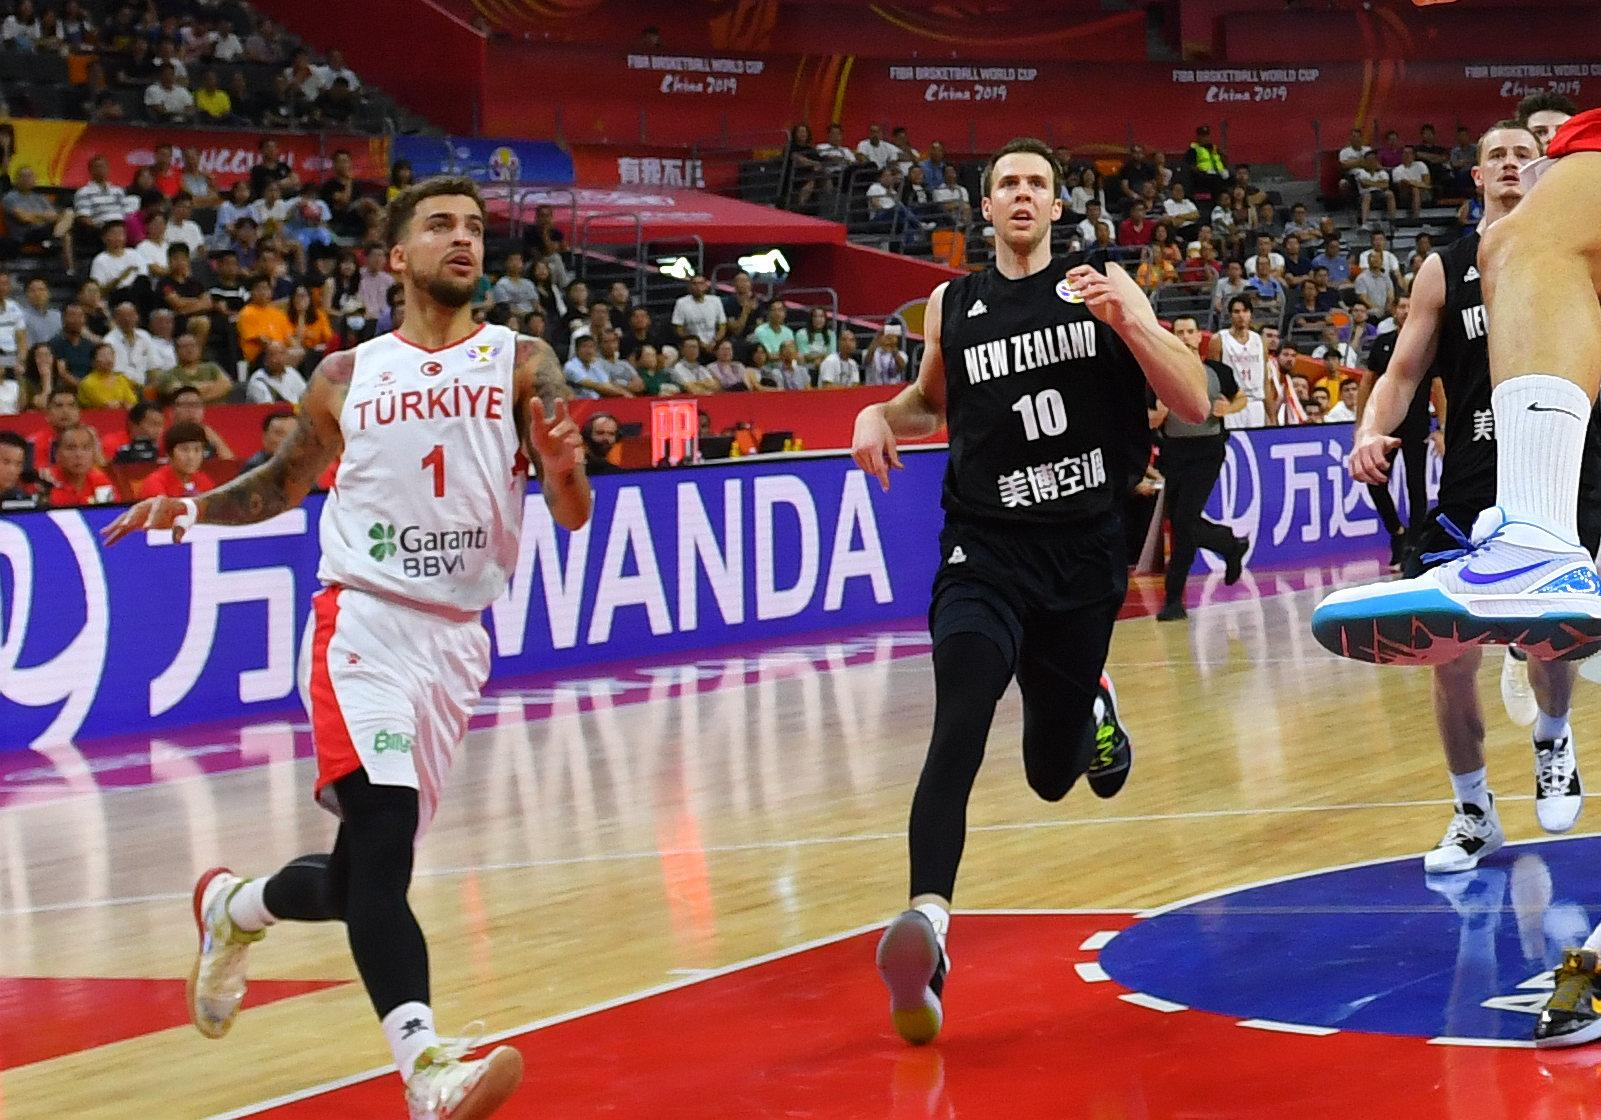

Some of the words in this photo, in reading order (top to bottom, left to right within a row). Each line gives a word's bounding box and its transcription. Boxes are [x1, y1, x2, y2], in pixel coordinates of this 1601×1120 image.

[924, 83, 971, 102] China
[973, 83, 1008, 102] 2019
[1205, 85, 1250, 104] China
[1253, 85, 1287, 102] 2019
[963, 336, 1009, 385] NEW
[1010, 320, 1097, 373] ZEALAND
[353, 377, 504, 431] TÜRKİYE
[1011, 388, 1068, 441] 10
[421, 444, 446, 498] 1
[997, 447, 1106, 508] 美博空调
[485, 468, 894, 658] WANDA
